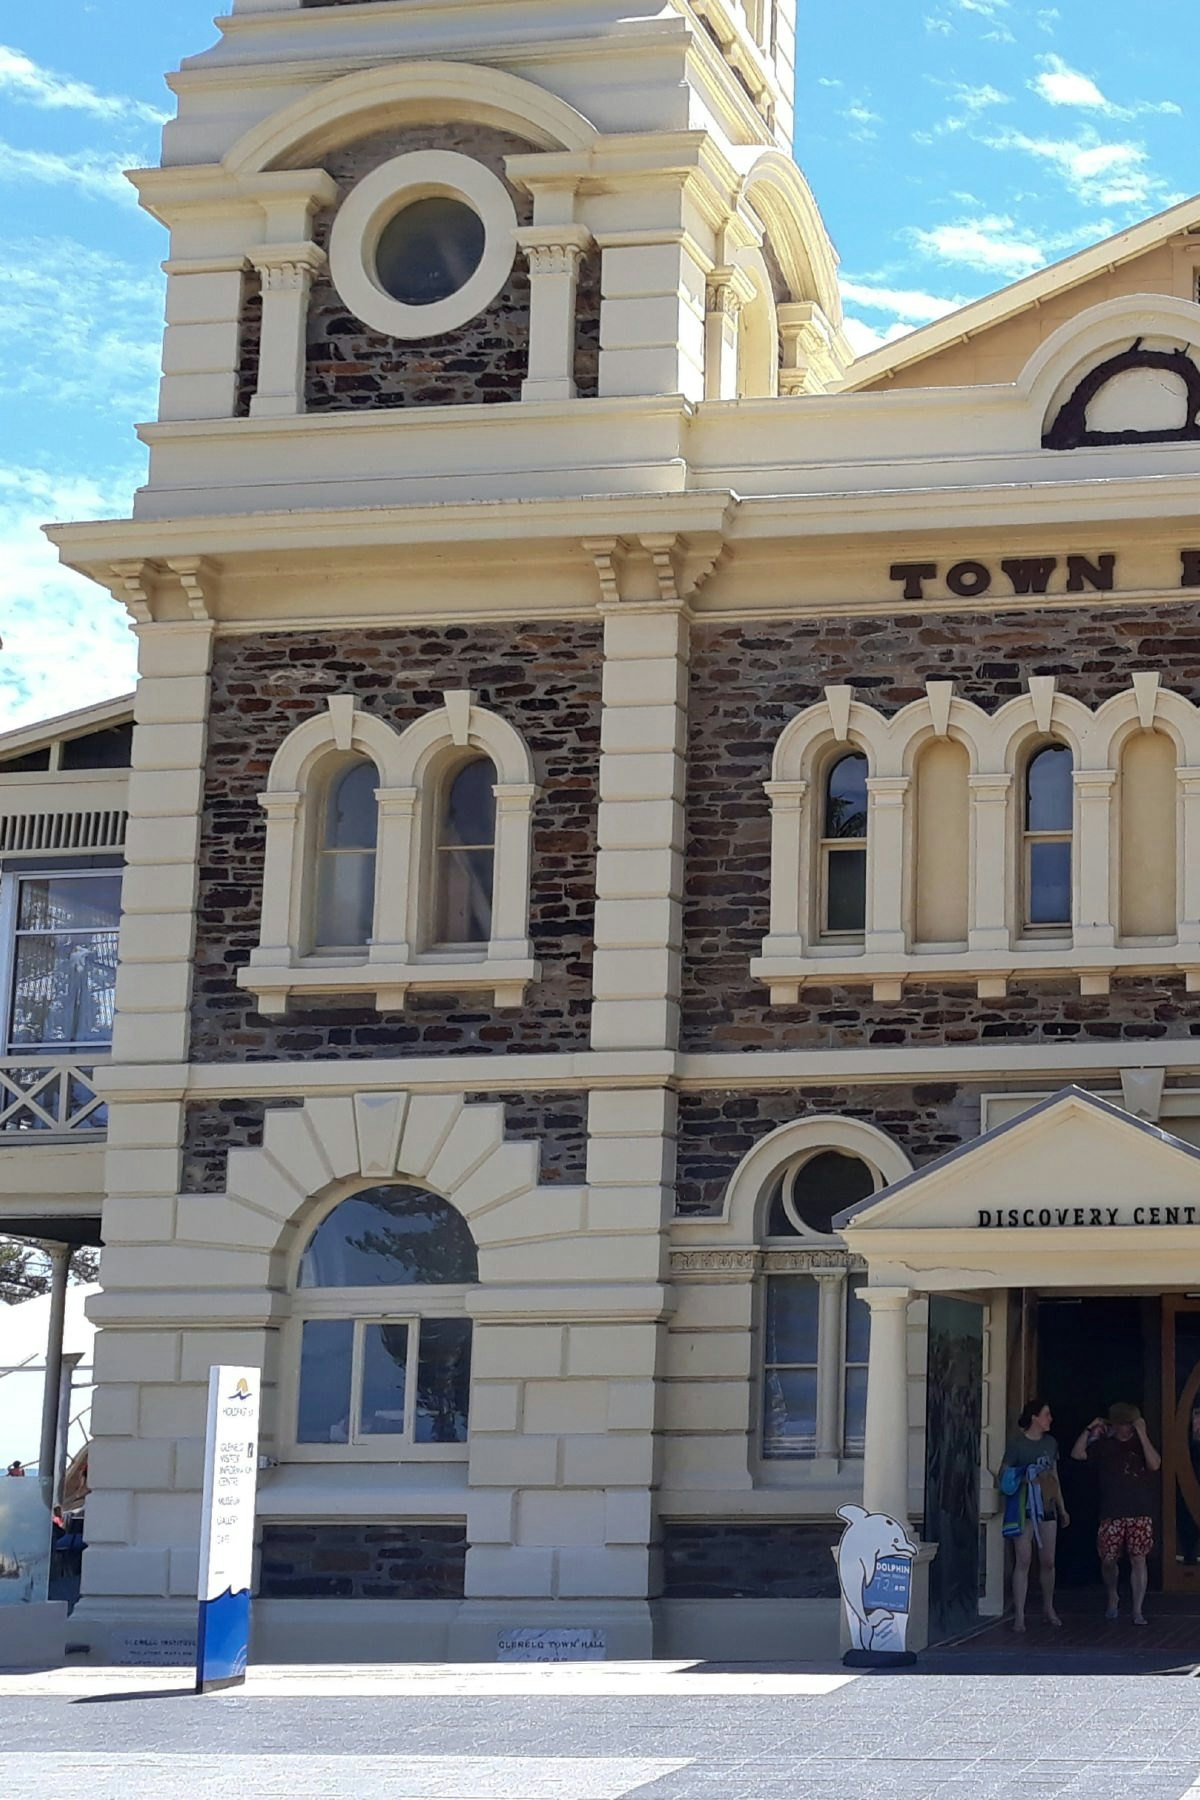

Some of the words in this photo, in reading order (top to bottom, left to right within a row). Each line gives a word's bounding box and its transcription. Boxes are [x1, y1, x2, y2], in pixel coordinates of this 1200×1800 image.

[890, 553, 1116, 600] TOWN
[977, 1208, 1120, 1228] DISCOVERY
[876, 1562, 910, 1574] DOLPHIN
[498, 1640, 544, 1649] GLENELG
[548, 1640, 577, 1649] TOWN
[581, 1640, 605, 1648] HALL
